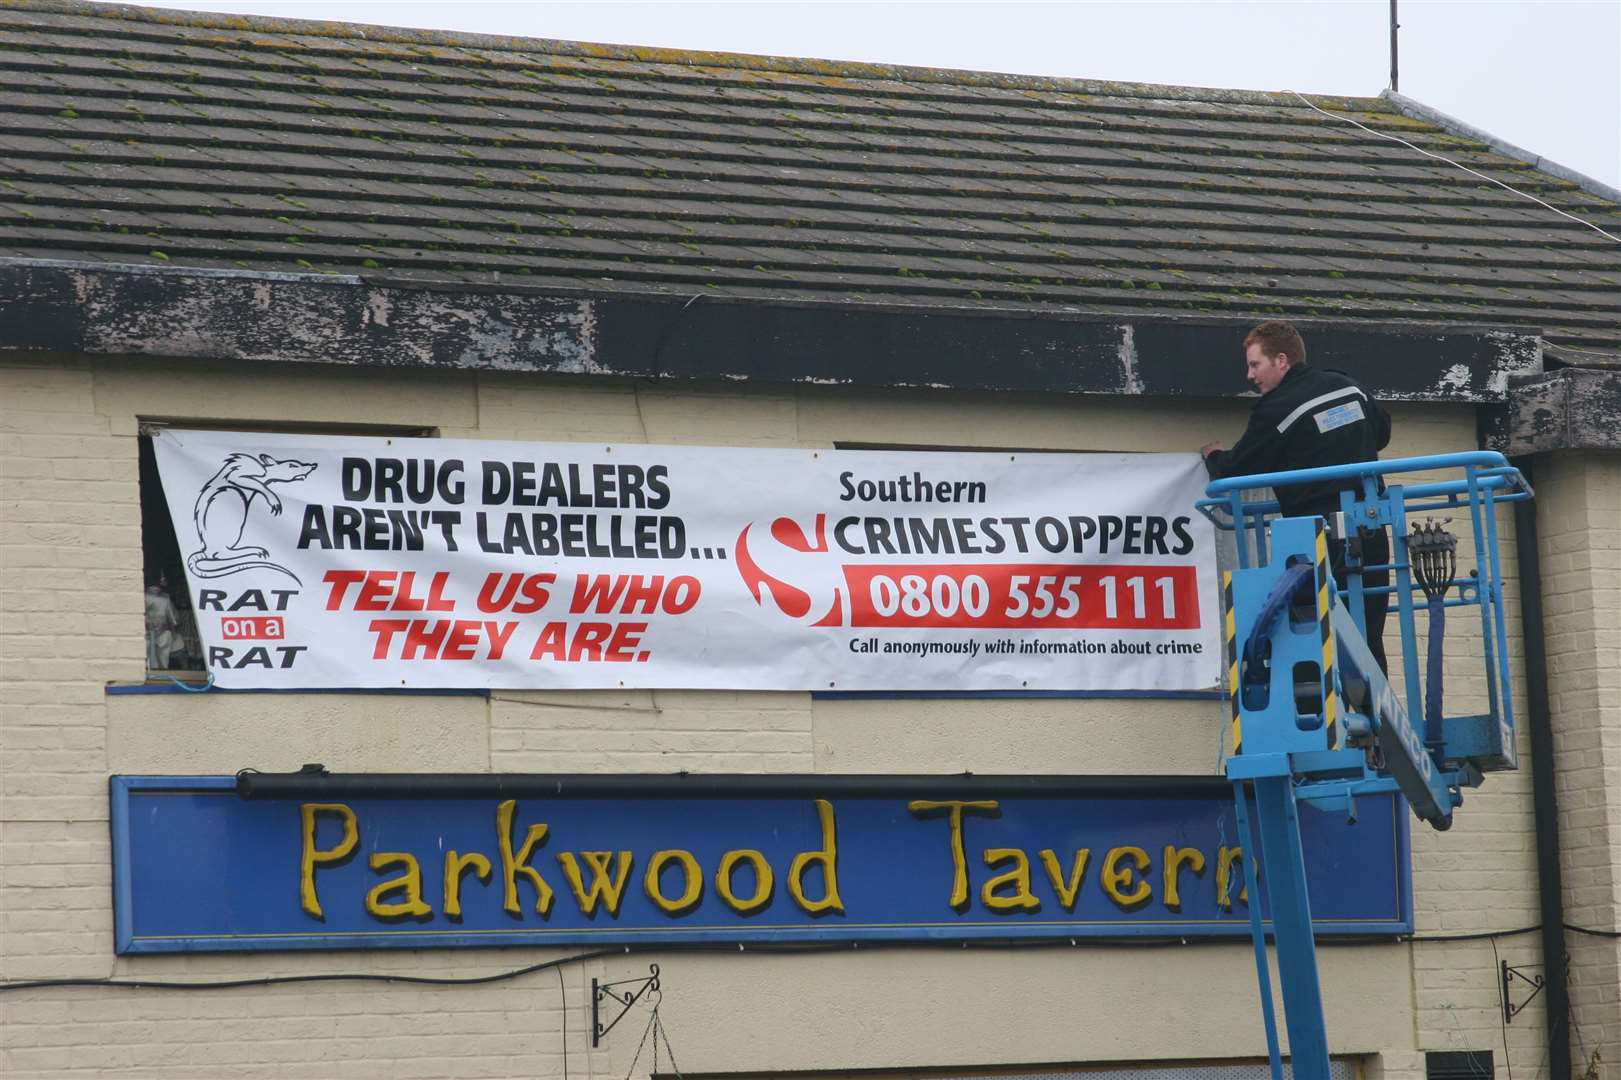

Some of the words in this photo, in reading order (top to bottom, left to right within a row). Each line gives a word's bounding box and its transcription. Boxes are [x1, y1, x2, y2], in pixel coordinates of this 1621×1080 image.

[341, 457, 466, 504] DRUG
[481, 460, 671, 509] DEALERS
[839, 471, 987, 503] Southern
[296, 504, 462, 552] AREN'T
[476, 511, 727, 560] LABELLED...
[833, 515, 1194, 556] CRIMESTOPPERS
[199, 589, 299, 612] RAT
[323, 570, 456, 612] TELL
[477, 572, 556, 614] US
[570, 574, 701, 615] WHO
[869, 574, 990, 618] 0800
[1005, 575, 1081, 618] 555
[1099, 576, 1175, 619] 111
[222, 617, 257, 638] on
[264, 619, 281, 637] a
[369, 619, 517, 661] THEY
[531, 621, 650, 662] ARE.
[849, 637, 879, 653] Call
[883, 638, 981, 658] anonymously
[984, 638, 1016, 654] with
[1019, 639, 1107, 654] information
[1110, 639, 1152, 655] about
[1155, 639, 1203, 655] crime
[209, 646, 308, 669] RAT
[302, 799, 843, 917] Parkwood
